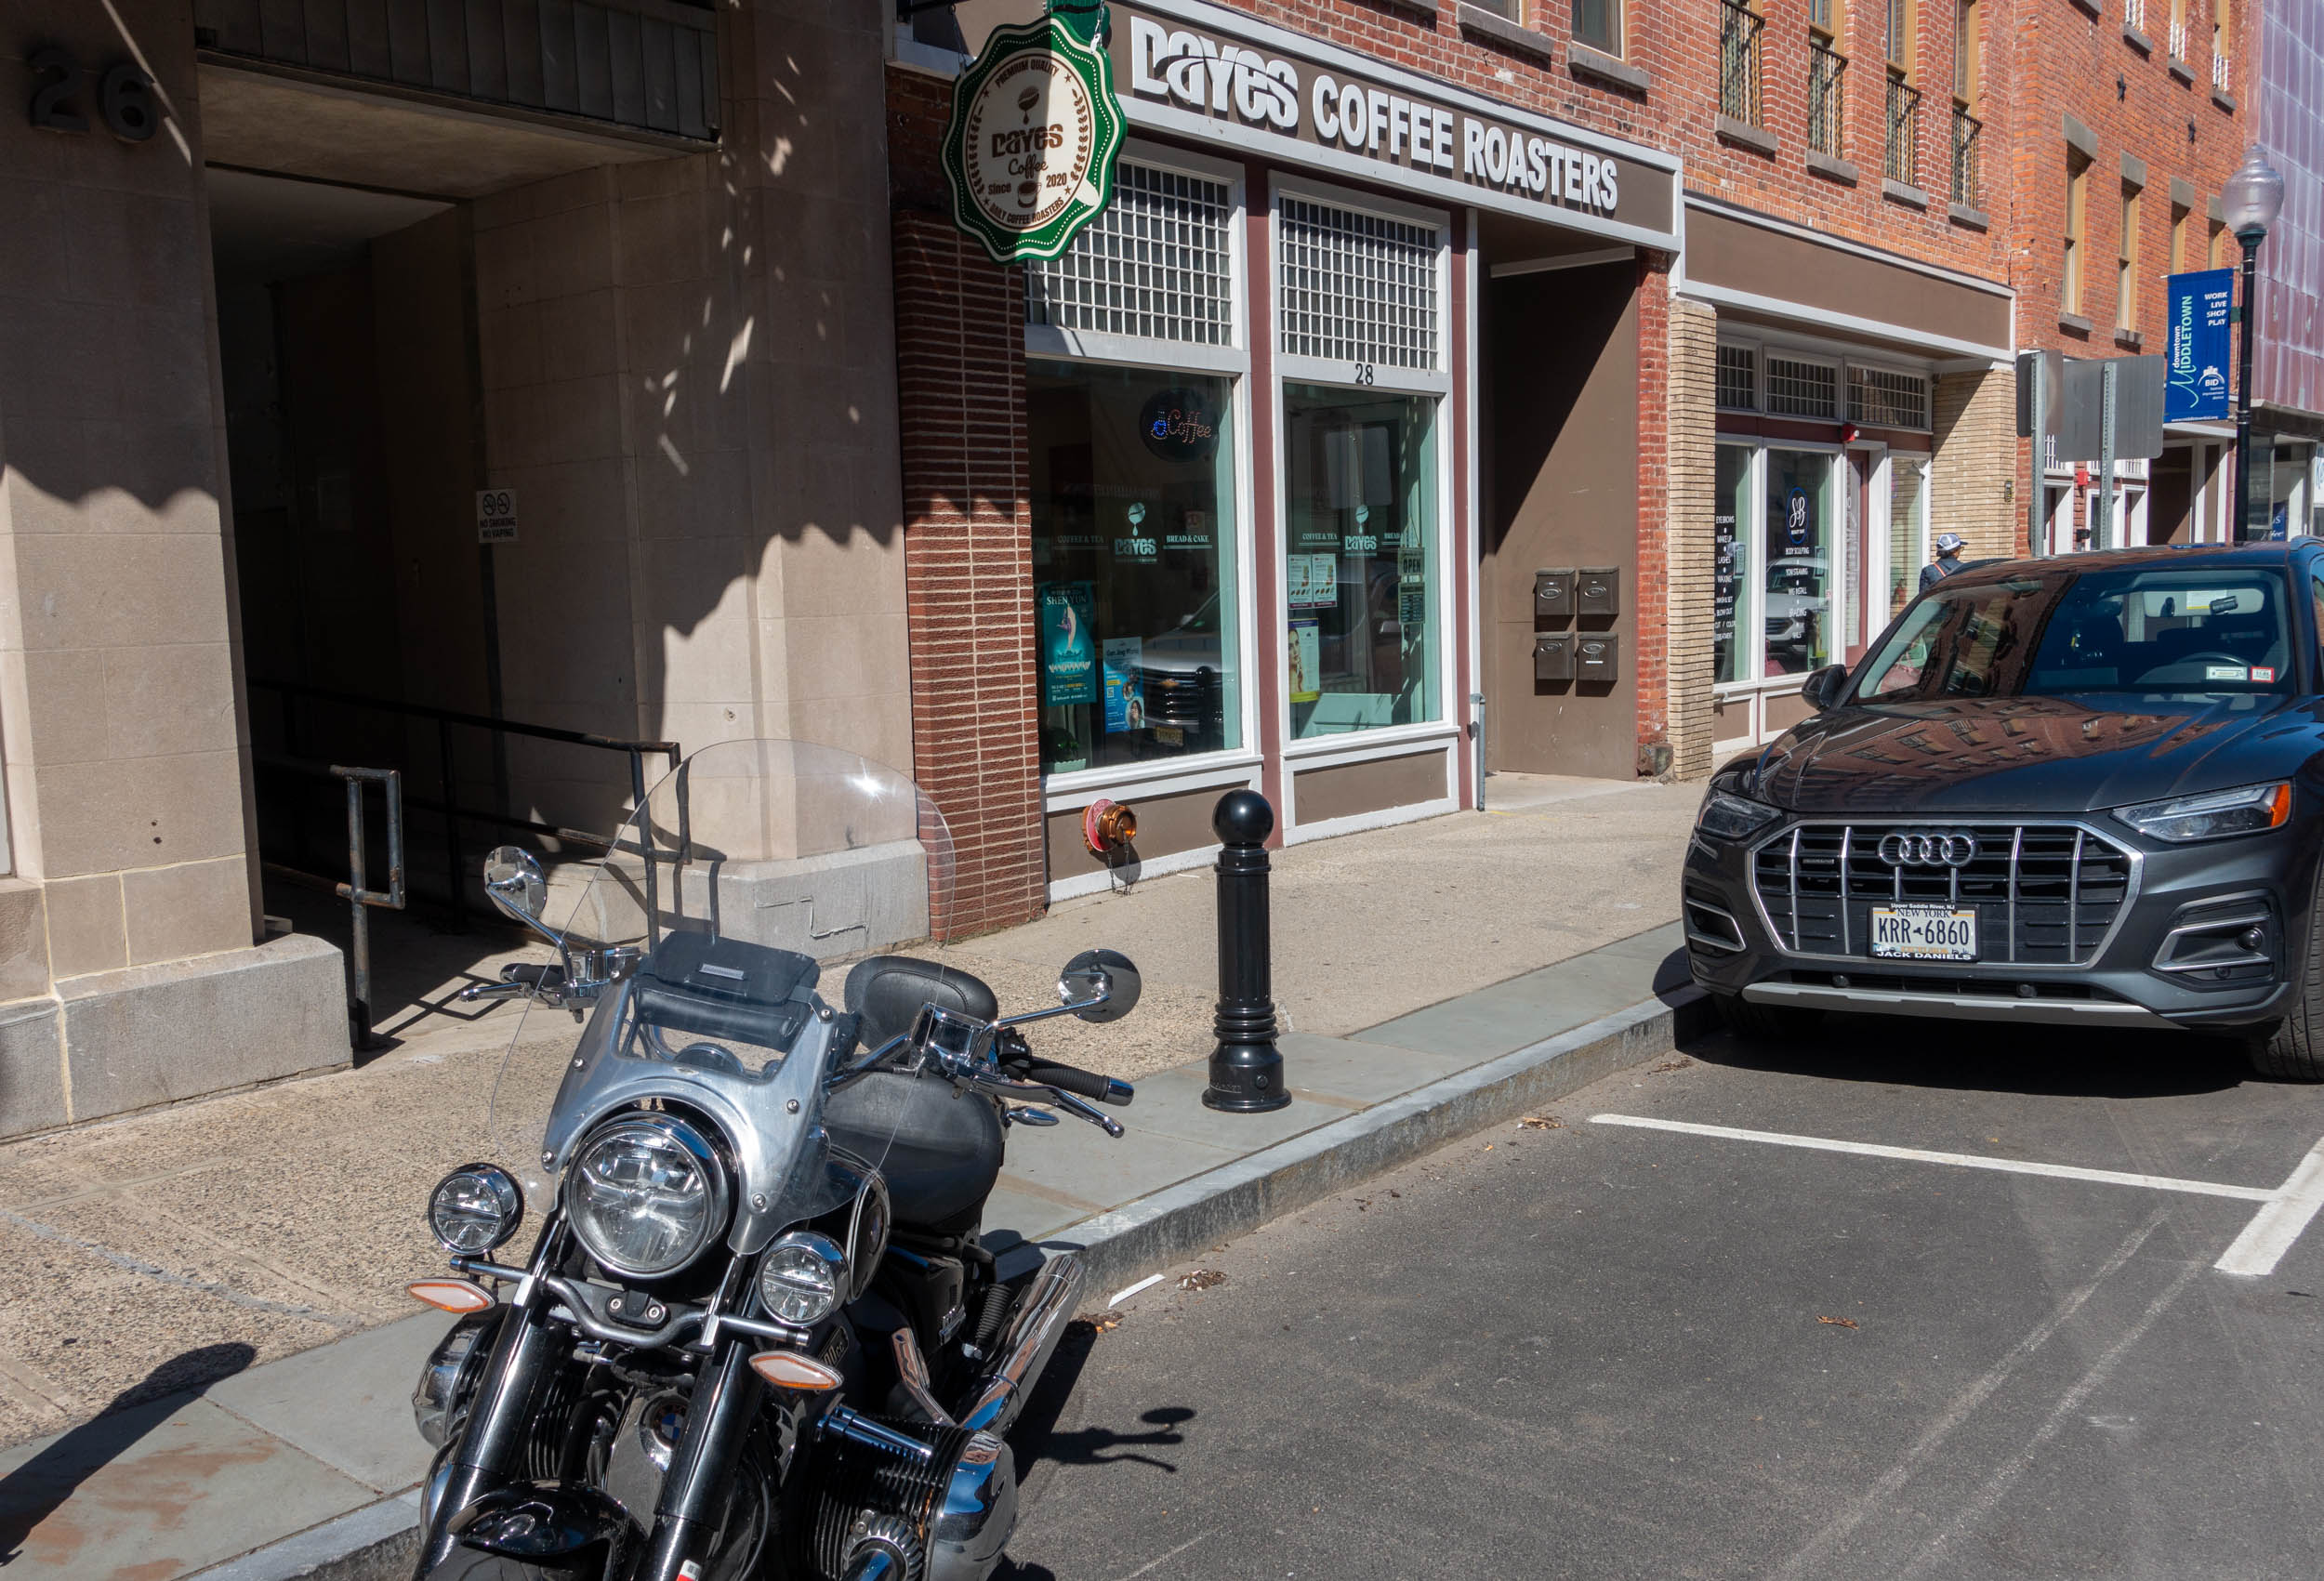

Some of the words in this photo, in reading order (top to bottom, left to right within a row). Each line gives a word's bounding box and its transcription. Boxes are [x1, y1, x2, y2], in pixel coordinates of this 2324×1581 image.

[995, 60, 1030, 87] PREMIUM
[1030, 59, 1060, 77] QUALITY
[29, 49, 158, 141] 26
[1313, 74, 1453, 169] COFFEE
[1464, 117, 1618, 211] ROASTERS
[1008, 153, 1049, 178] Coffee
[988, 181, 1011, 195] since
[1046, 173, 1067, 189] 2020
[989, 202, 1007, 221] DAILY
[1007, 213, 1030, 225] COFFEE
[1031, 196, 1065, 223] ROASTERS
[2204, 292, 2227, 300] WORK
[2211, 300, 2226, 309] LIVE
[2206, 310, 2226, 318] SHOP
[2172, 325, 2181, 368] downtown
[1355, 362, 1374, 385] 28
[2205, 378, 2219, 387] BID
[1168, 408, 1211, 444] Coffee
[1057, 534, 1083, 543] COFFEE
[1166, 534, 1186, 543] BREAD
[1403, 559, 1420, 573] OPEN
[1047, 596, 1068, 605] SHEN
[1069, 594, 1087, 603] YUN
[1896, 908, 1921, 917] NEW
[1923, 909, 1950, 918] YORK
[1915, 952, 1972, 960] DANIELS
